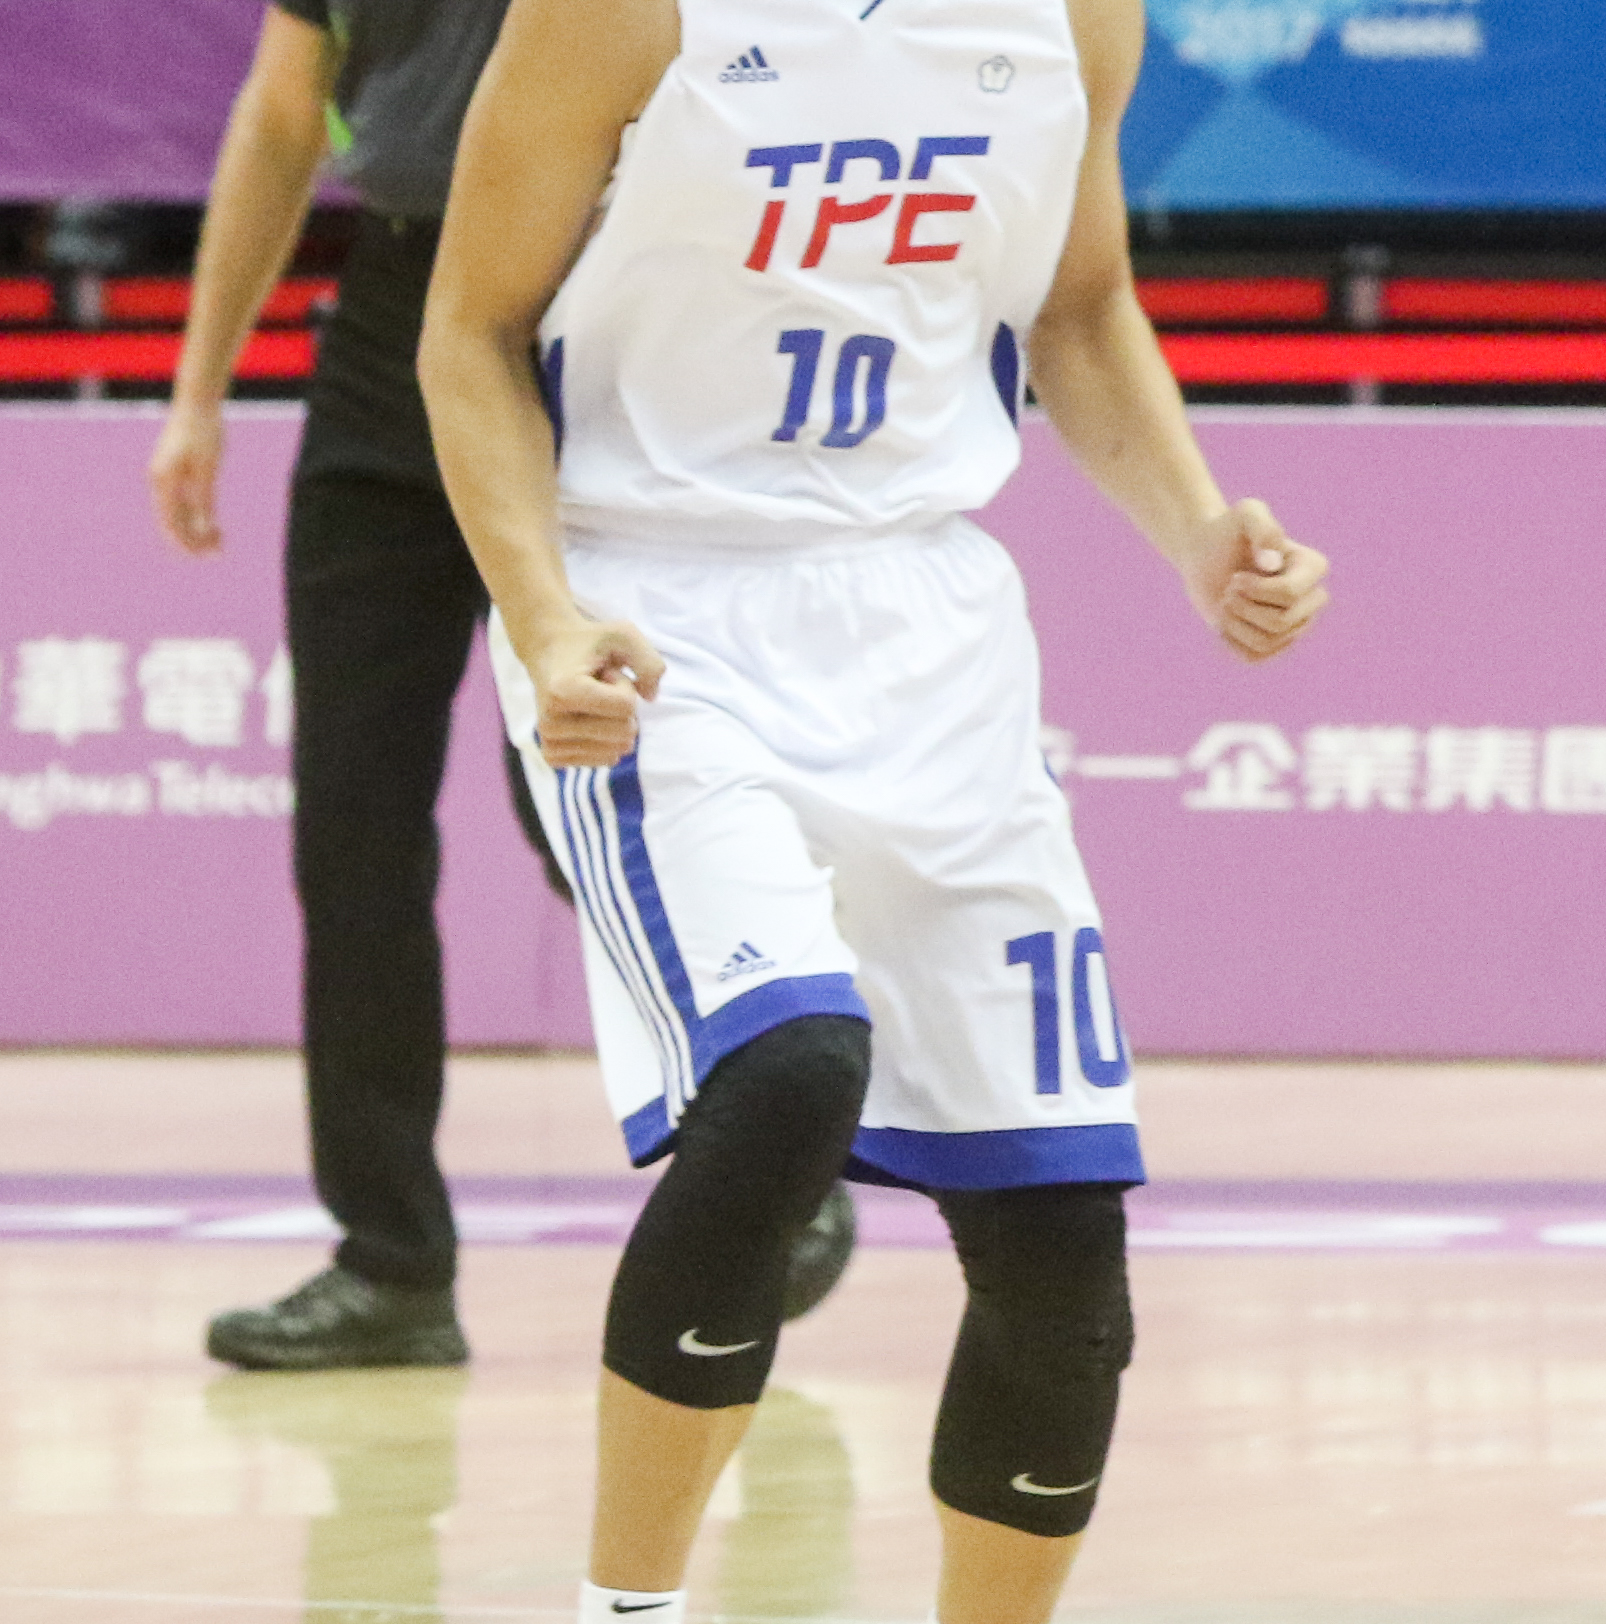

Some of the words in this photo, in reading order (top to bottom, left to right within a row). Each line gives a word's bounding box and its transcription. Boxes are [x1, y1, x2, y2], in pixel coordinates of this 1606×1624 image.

[718, 68, 780, 83] adidas
[744, 136, 990, 272] TPE
[771, 329, 897, 448] 10
[0, 637, 293, 747] 華電
[1006, 927, 1131, 1096] 10
